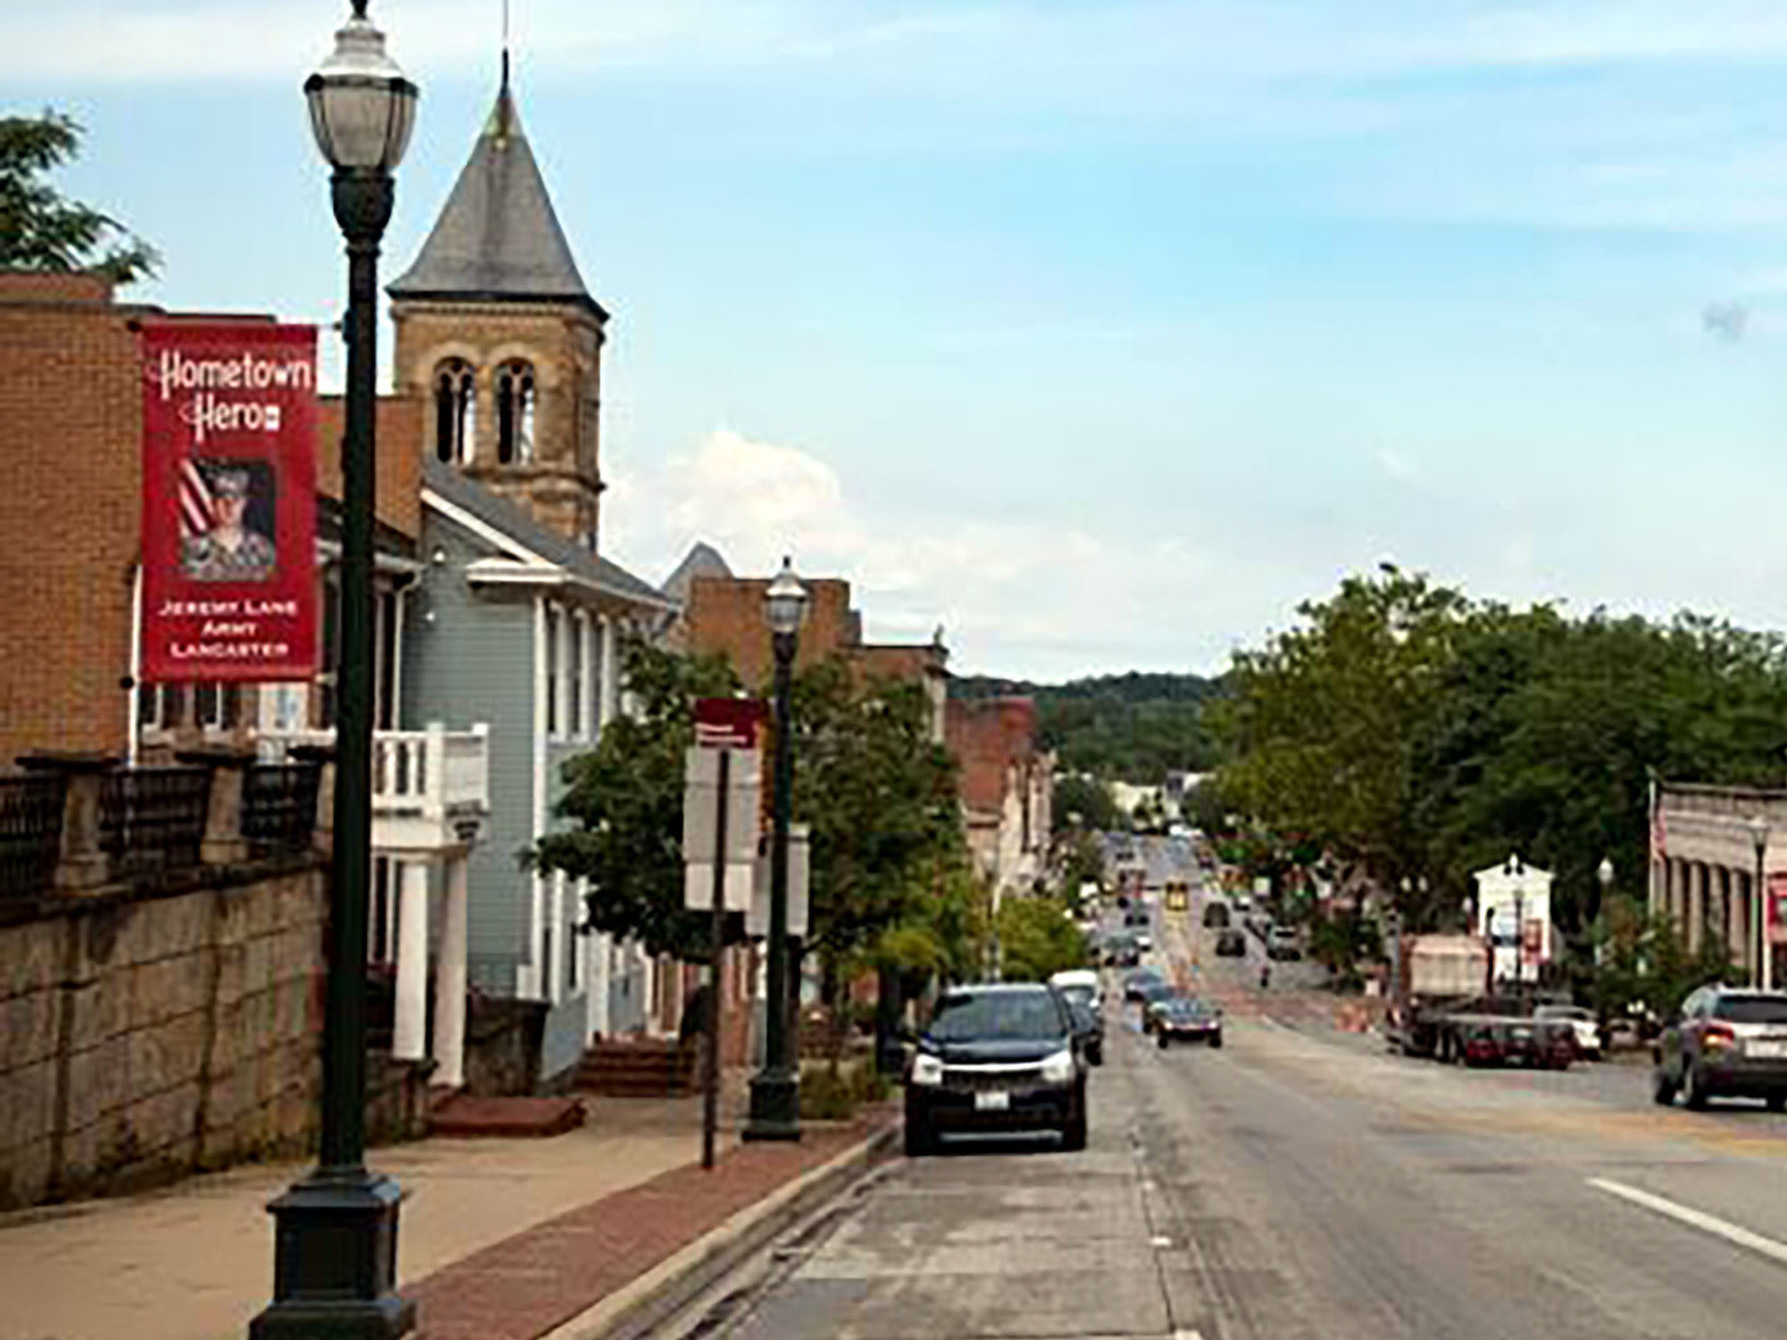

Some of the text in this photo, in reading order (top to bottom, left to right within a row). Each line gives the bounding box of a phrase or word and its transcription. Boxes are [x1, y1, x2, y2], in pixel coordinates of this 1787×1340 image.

[145, 350, 311, 400] Hometown
[245, 600, 297, 616] LANE
[201, 620, 258, 636] ARMY
